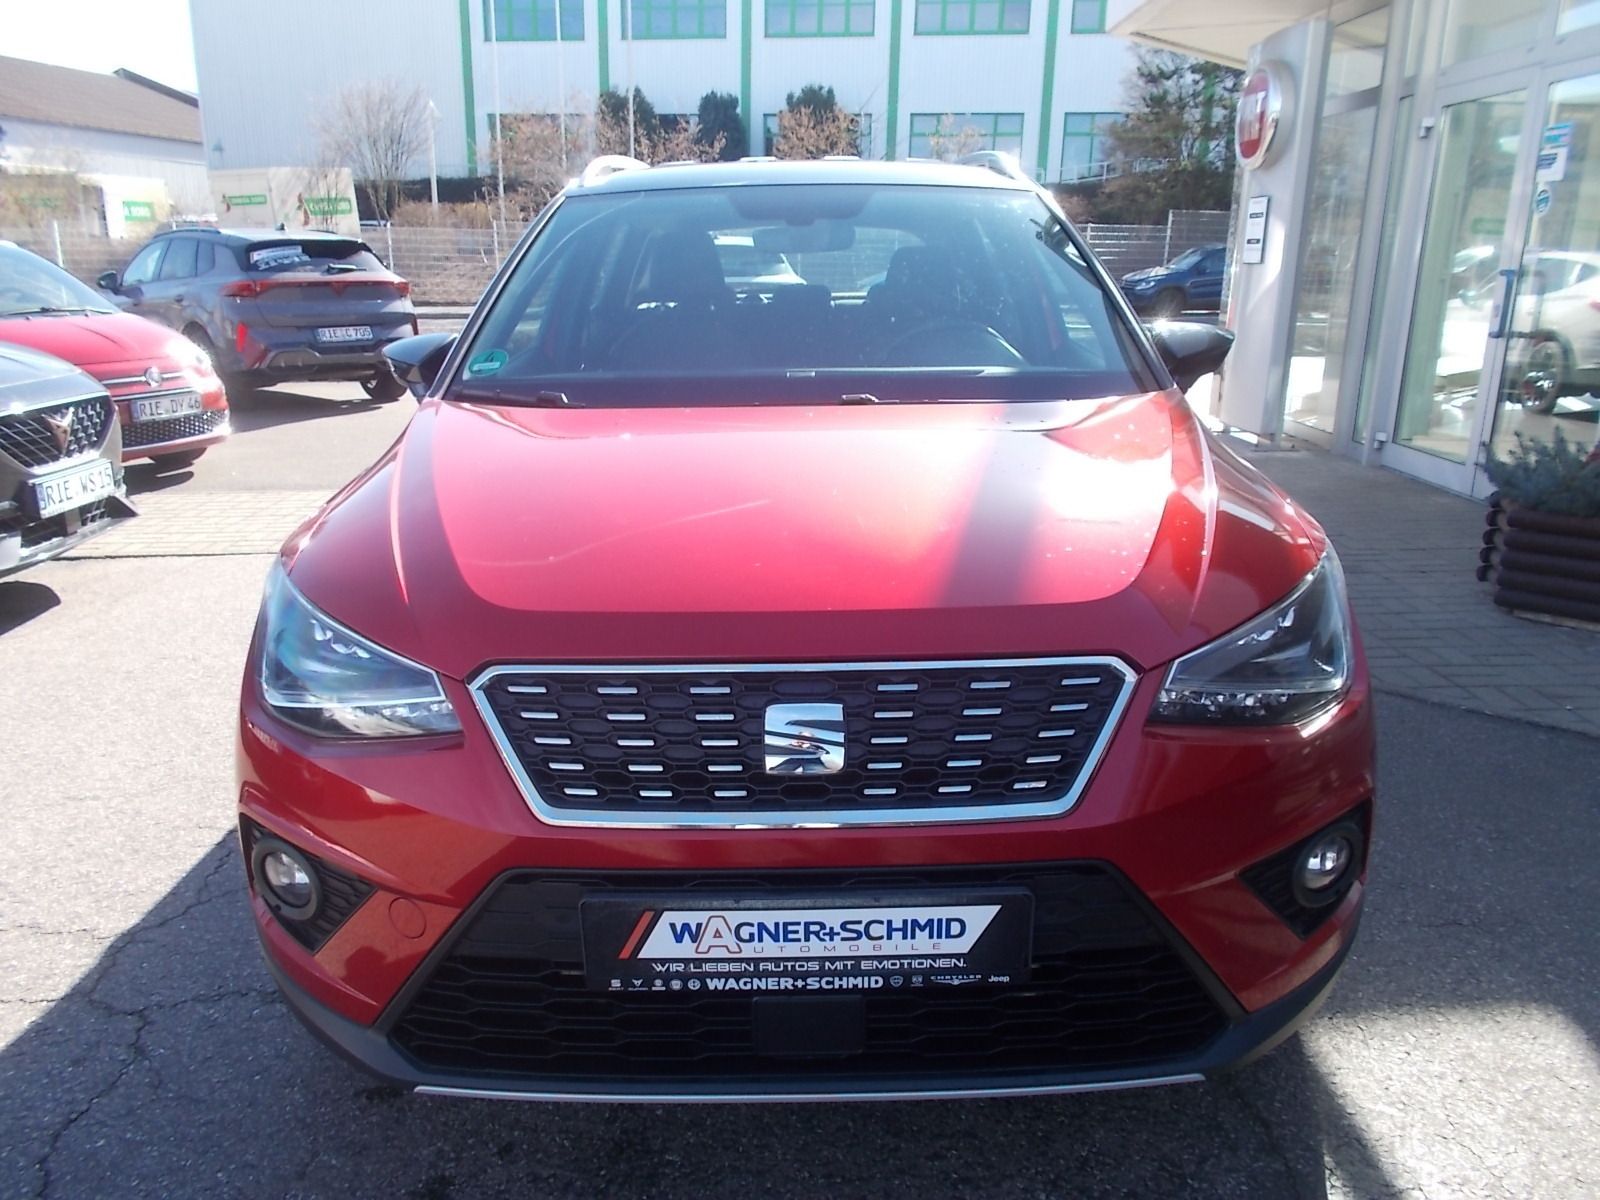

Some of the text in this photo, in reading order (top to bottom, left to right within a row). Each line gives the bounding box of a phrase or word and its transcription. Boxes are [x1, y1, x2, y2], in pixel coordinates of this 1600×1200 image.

[320, 329, 339, 340] RIE
[345, 329, 352, 338] C
[139, 400, 164, 417] RIE
[171, 399, 184, 413] DY
[45, 468, 113, 506] RIE WS 15
[668, 915, 967, 954] WAGNER+SCHMID
[651, 958, 967, 972] WIR LIEBEN AUTOS MIT EMOTIONEN.
[705, 976, 884, 991] WAGNER+SCHMID
[987, 974, 1010, 984] Jeep
